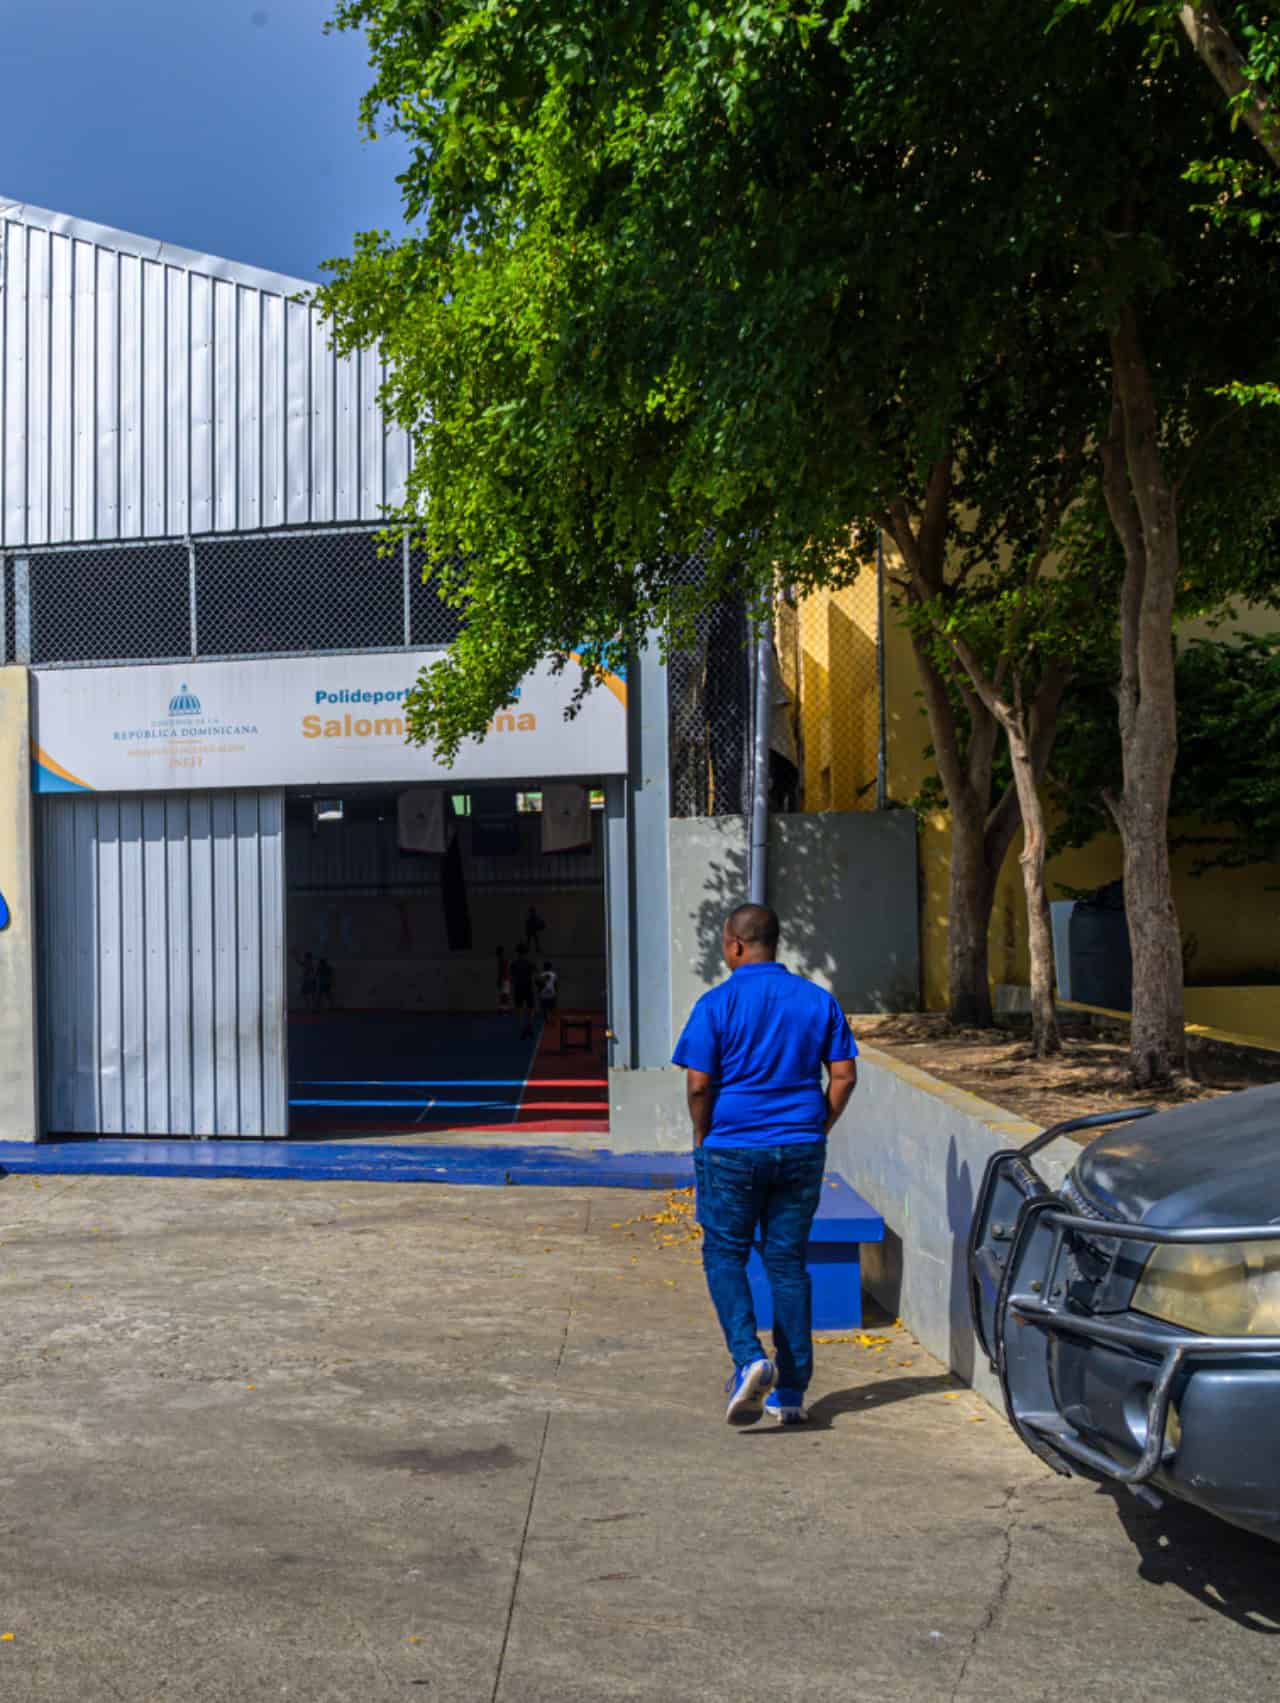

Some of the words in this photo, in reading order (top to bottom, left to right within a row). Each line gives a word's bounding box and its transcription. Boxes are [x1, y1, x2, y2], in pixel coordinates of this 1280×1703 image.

[315, 688, 411, 705] Polideport
[112, 726, 177, 741] REPÚBLICA
[181, 724, 259, 738] DOMINICANA
